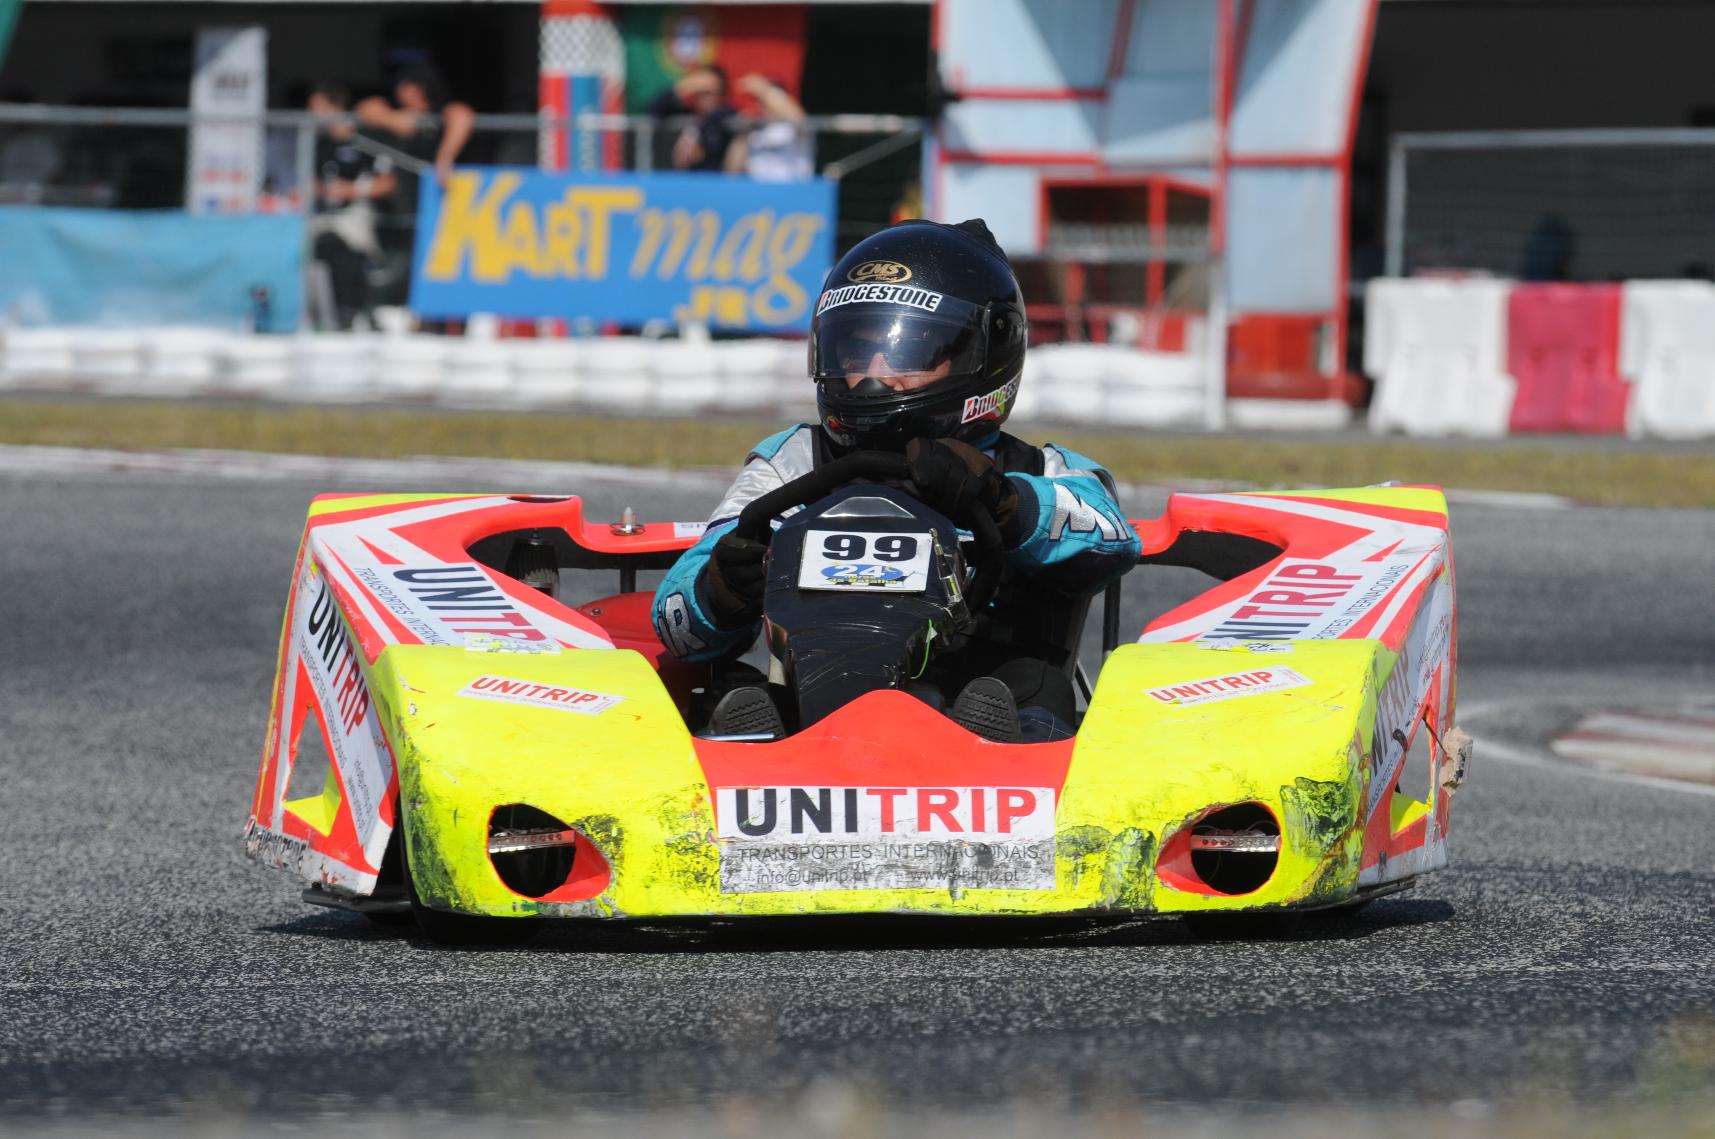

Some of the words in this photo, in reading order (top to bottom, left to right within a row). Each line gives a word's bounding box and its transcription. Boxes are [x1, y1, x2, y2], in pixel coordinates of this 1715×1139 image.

[857, 263, 899, 276] CMS
[818, 285, 941, 313] BRIDGESTONE
[822, 534, 918, 562] 99
[833, 565, 886, 578] 24
[1202, 563, 1364, 640] NITRIP
[308, 581, 370, 736] UNITRIP
[471, 677, 599, 704] UNITRIP
[1150, 671, 1273, 702] UNITRIP
[735, 788, 1037, 837] UNITRIP
[737, 844, 873, 861] TRANSPORTES
